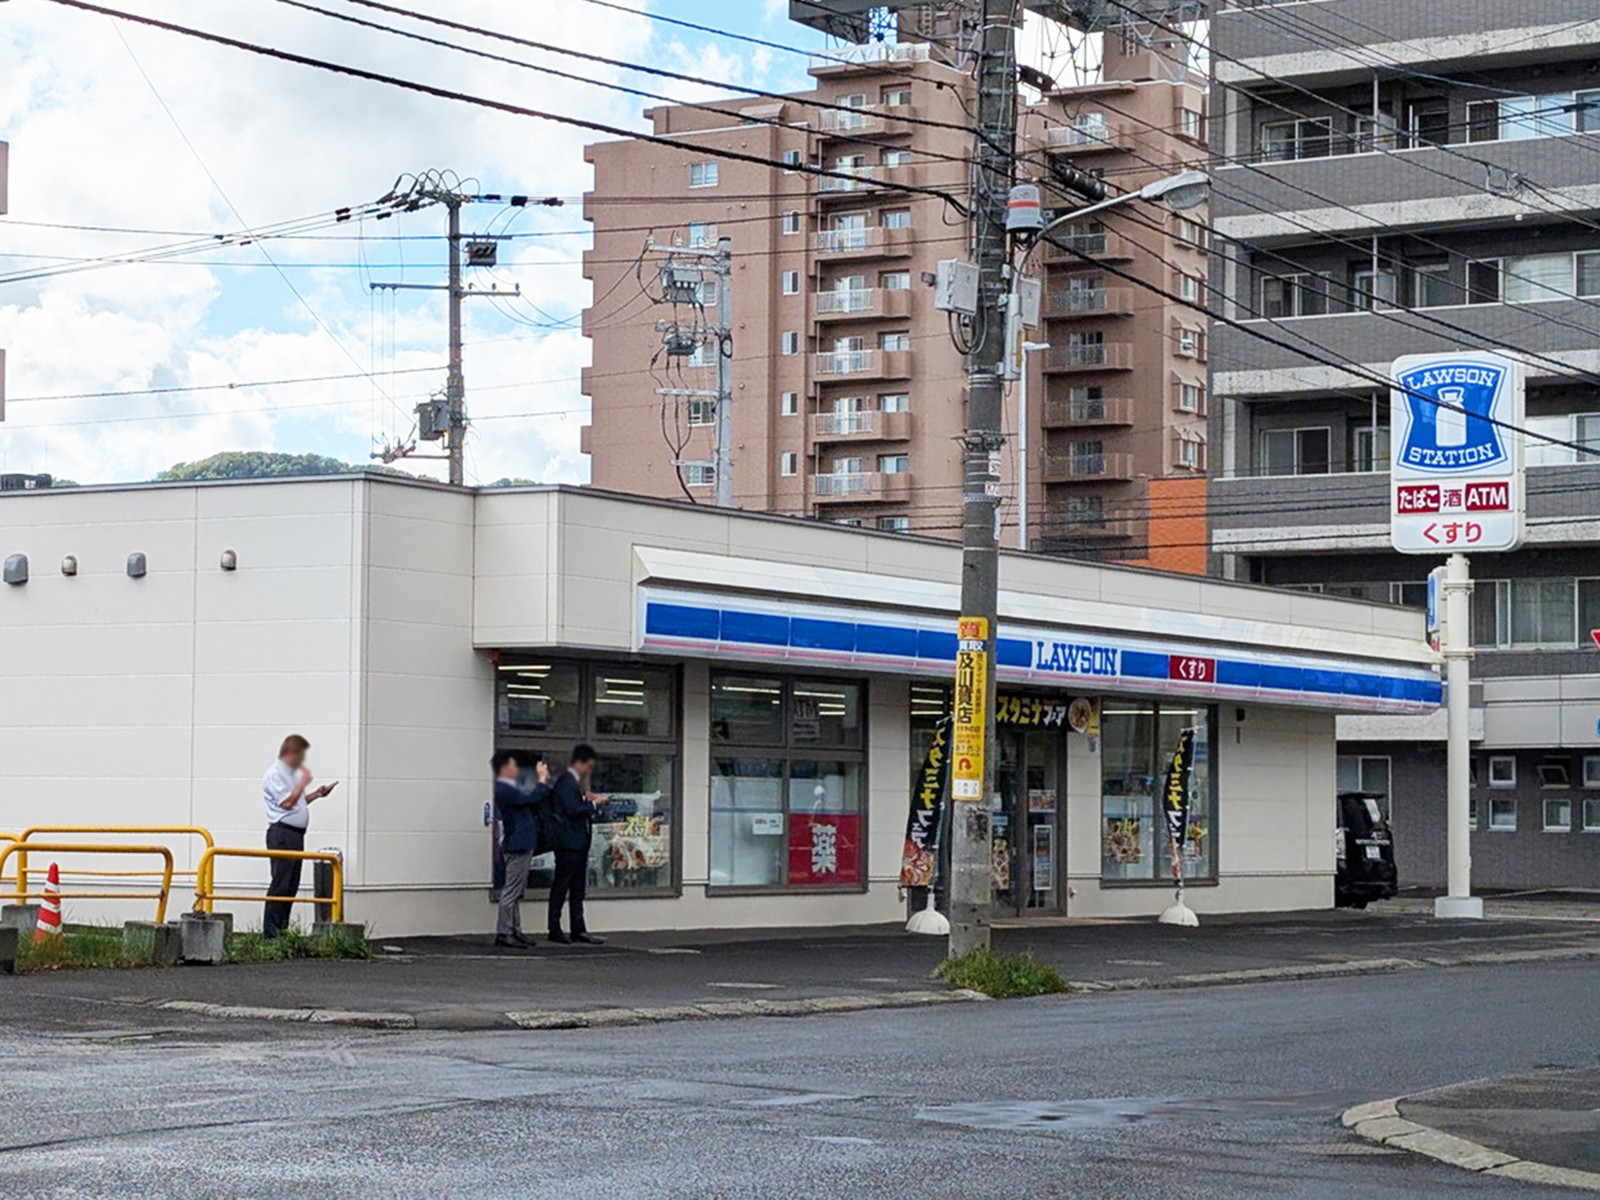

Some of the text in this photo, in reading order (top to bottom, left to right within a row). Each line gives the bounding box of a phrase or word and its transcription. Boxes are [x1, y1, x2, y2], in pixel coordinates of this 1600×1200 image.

[1407, 368, 1496, 390] LAWSON
[1408, 443, 1495, 466] STATION
[1399, 487, 1507, 509] たばこ 酒 ATM
[1423, 522, 1483, 544] くすり
[1036, 641, 1118, 676] LAWSON
[1178, 658, 1207, 680] くすり
[811, 824, 837, 874] 薬
